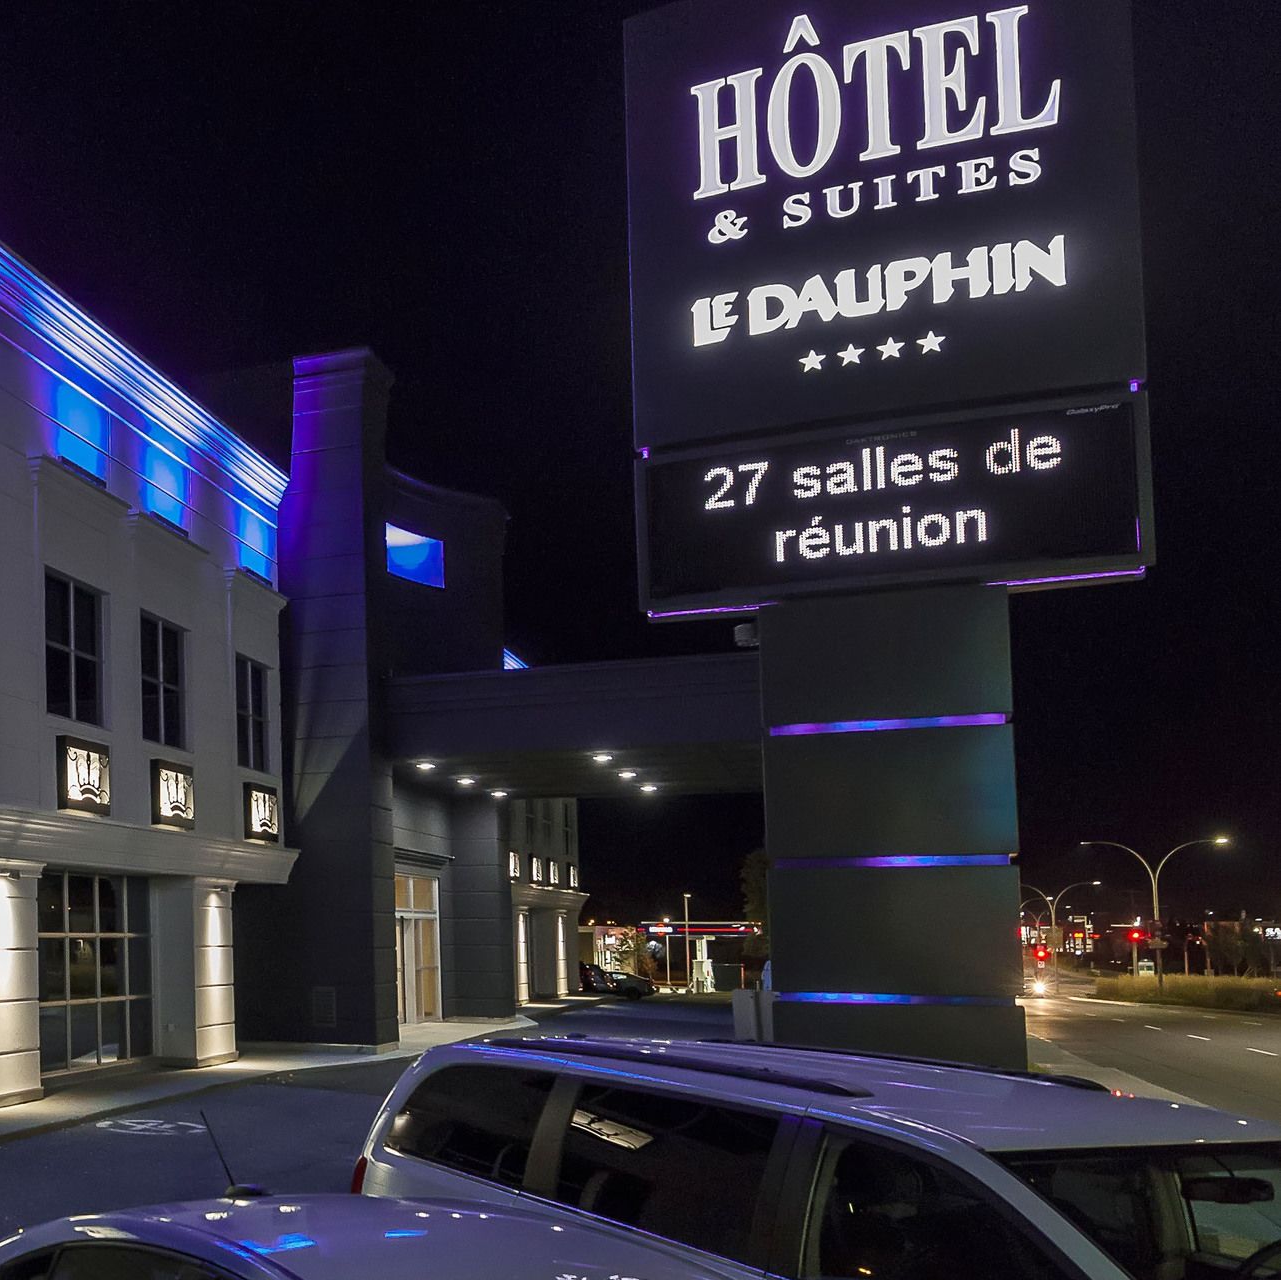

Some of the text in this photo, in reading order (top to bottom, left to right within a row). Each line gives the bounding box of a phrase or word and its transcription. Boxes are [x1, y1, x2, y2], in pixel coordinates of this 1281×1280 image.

[690, 4, 1061, 201] HÔTEL
[707, 147, 1042, 244] & SUITES
[690, 234, 1067, 348] LE DAUPHIN
[703, 427, 1062, 511] 27 salles de
[775, 505, 988, 563] réunion
